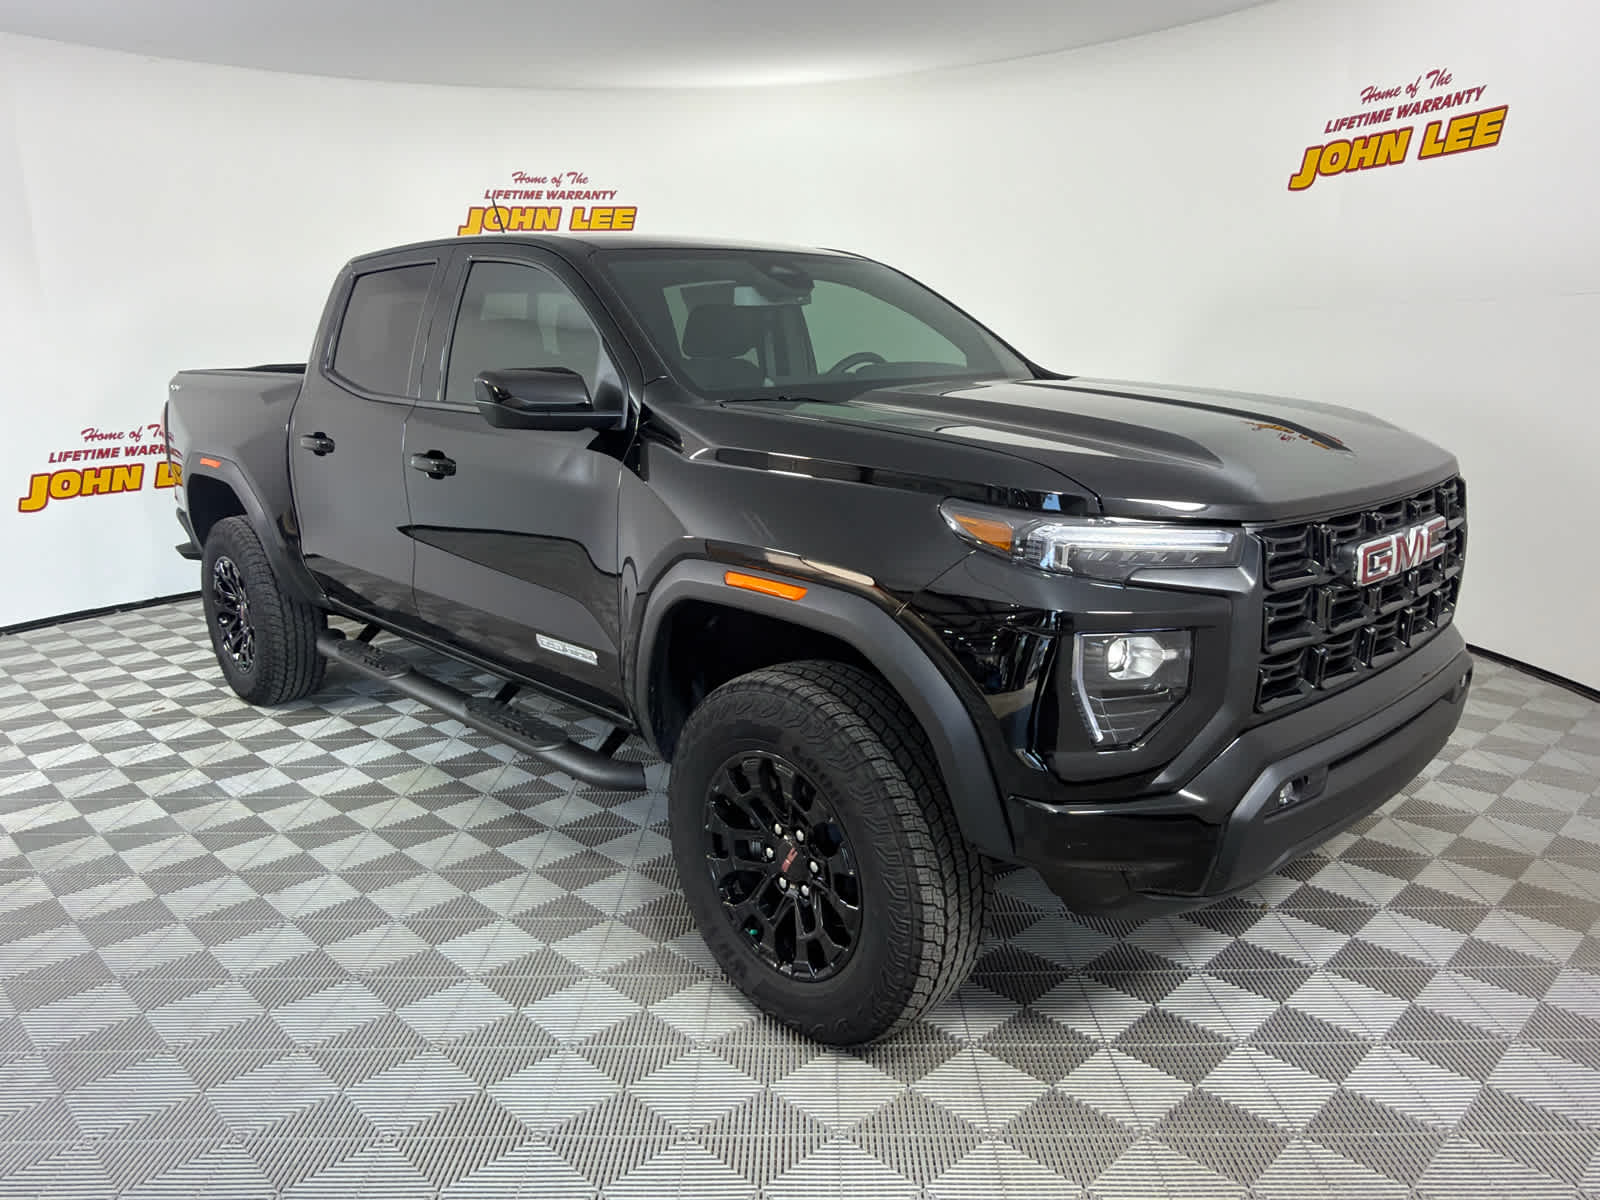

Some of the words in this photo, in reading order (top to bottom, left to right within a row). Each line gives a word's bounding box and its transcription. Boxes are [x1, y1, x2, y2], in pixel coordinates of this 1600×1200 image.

[1360, 85, 1402, 104] Home
[1405, 76, 1423, 98] of
[1425, 67, 1453, 90] The
[1324, 107, 1394, 134] LIFETIME
[1396, 84, 1487, 120] WARRANTY
[1287, 126, 1414, 191] JOHN
[1417, 104, 1509, 160] LEE
[484, 190, 543, 200] LIFETIME
[546, 190, 617, 201] WARRANTY
[511, 171, 548, 184] Home
[550, 173, 565, 188] of
[566, 171, 589, 184] The
[457, 205, 562, 236] JOHN
[569, 206, 637, 231] LEE
[81, 427, 125, 443] Home
[128, 426, 143, 442] of
[48, 447, 121, 464] LIFETIME
[18, 463, 145, 513] JOHN
[1357, 515, 1447, 587] GMC
